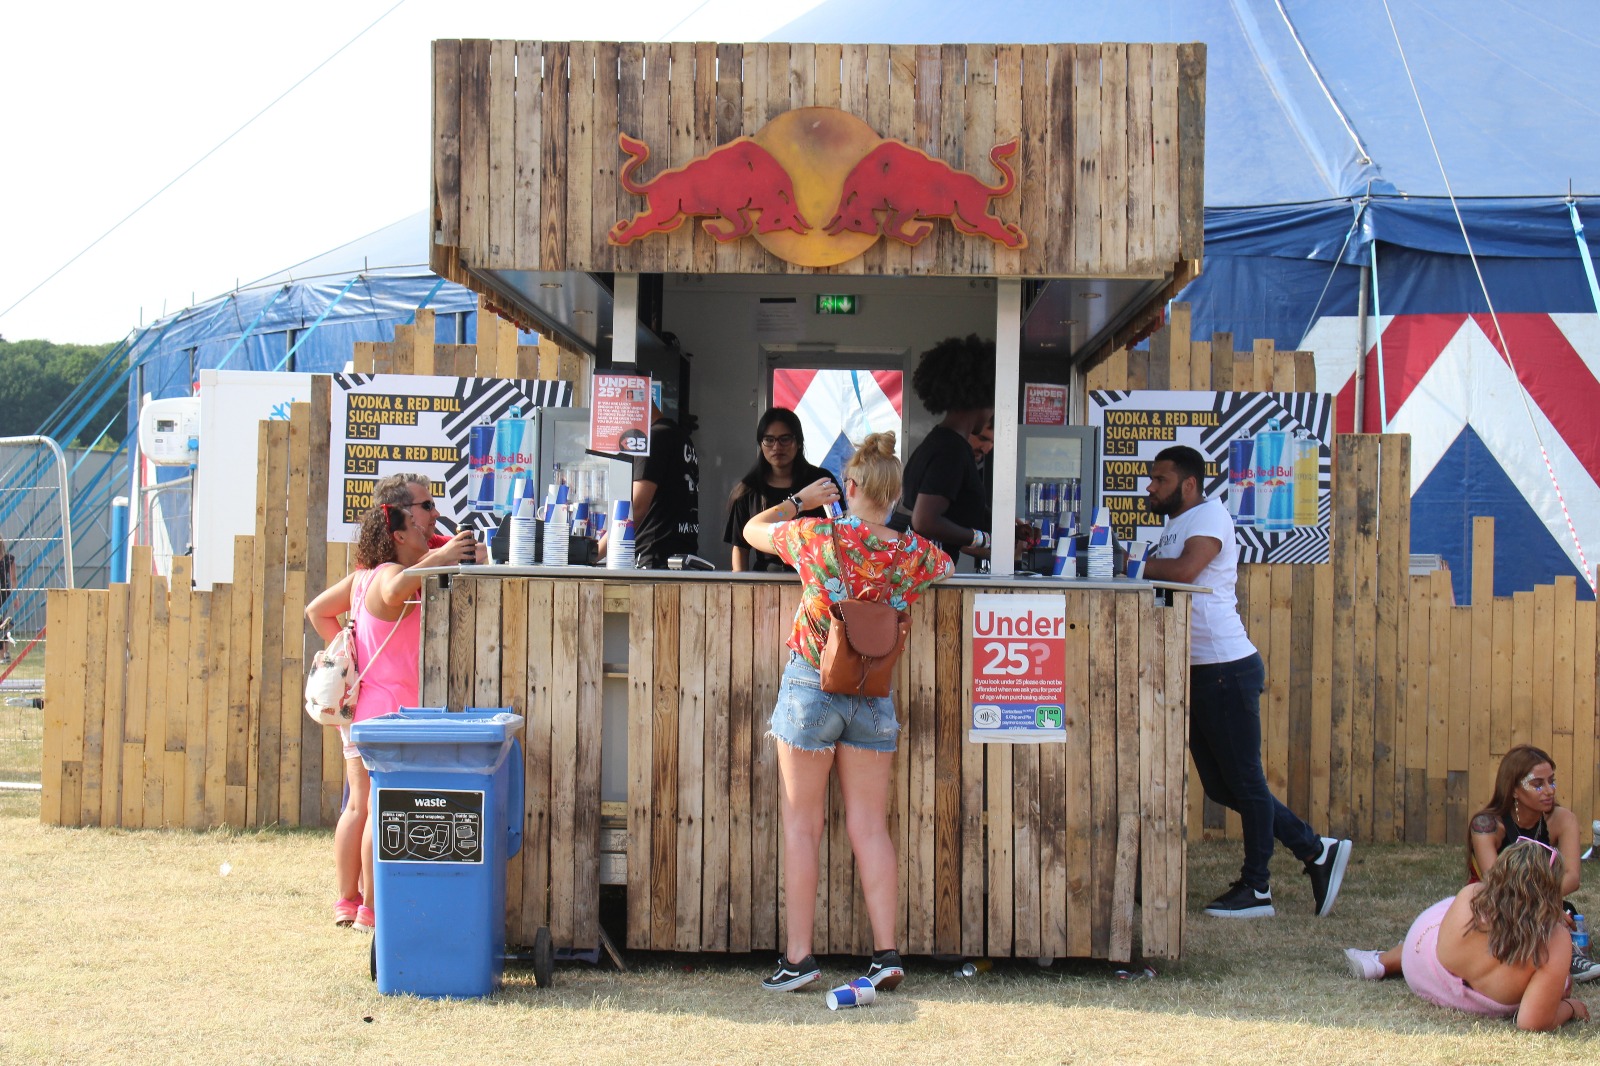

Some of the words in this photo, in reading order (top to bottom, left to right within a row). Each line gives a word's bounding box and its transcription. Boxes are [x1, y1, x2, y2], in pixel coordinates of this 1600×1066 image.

[598, 377, 645, 388] UNDER
[598, 388, 621, 398] 25?
[1029, 389, 1063, 398] UNDER
[350, 395, 391, 409] VODKA
[394, 398, 403, 410] &
[408, 397, 430, 410] RED
[434, 398, 460, 411] BULL
[349, 410, 415, 424] SUGARFREE
[1106, 412, 1148, 425] VODKA
[1152, 413, 1161, 425] &
[1165, 412, 1188, 426] RED
[1192, 413, 1219, 426] BULL
[349, 425, 376, 438] 9.50
[1106, 427, 1174, 440] SUGARFREE
[626, 437, 646, 450] 25
[1107, 441, 1134, 454] 9.50
[348, 445, 389, 459] VODKA
[393, 447, 401, 459] &
[406, 447, 428, 460] RED
[432, 448, 459, 461] BULL
[516, 453, 532, 464] Bul
[348, 460, 375, 473] 9.50
[1106, 462, 1148, 475] VODKA
[1276, 466, 1293, 477] Bul
[346, 480, 374, 494] RUM
[1106, 477, 1134, 490] 9.50
[1106, 497, 1133, 510] RUM
[1137, 498, 1146, 511] &
[975, 610, 1064, 636] Under
[982, 642, 1050, 675] 25?
[415, 798, 447, 807] waste
